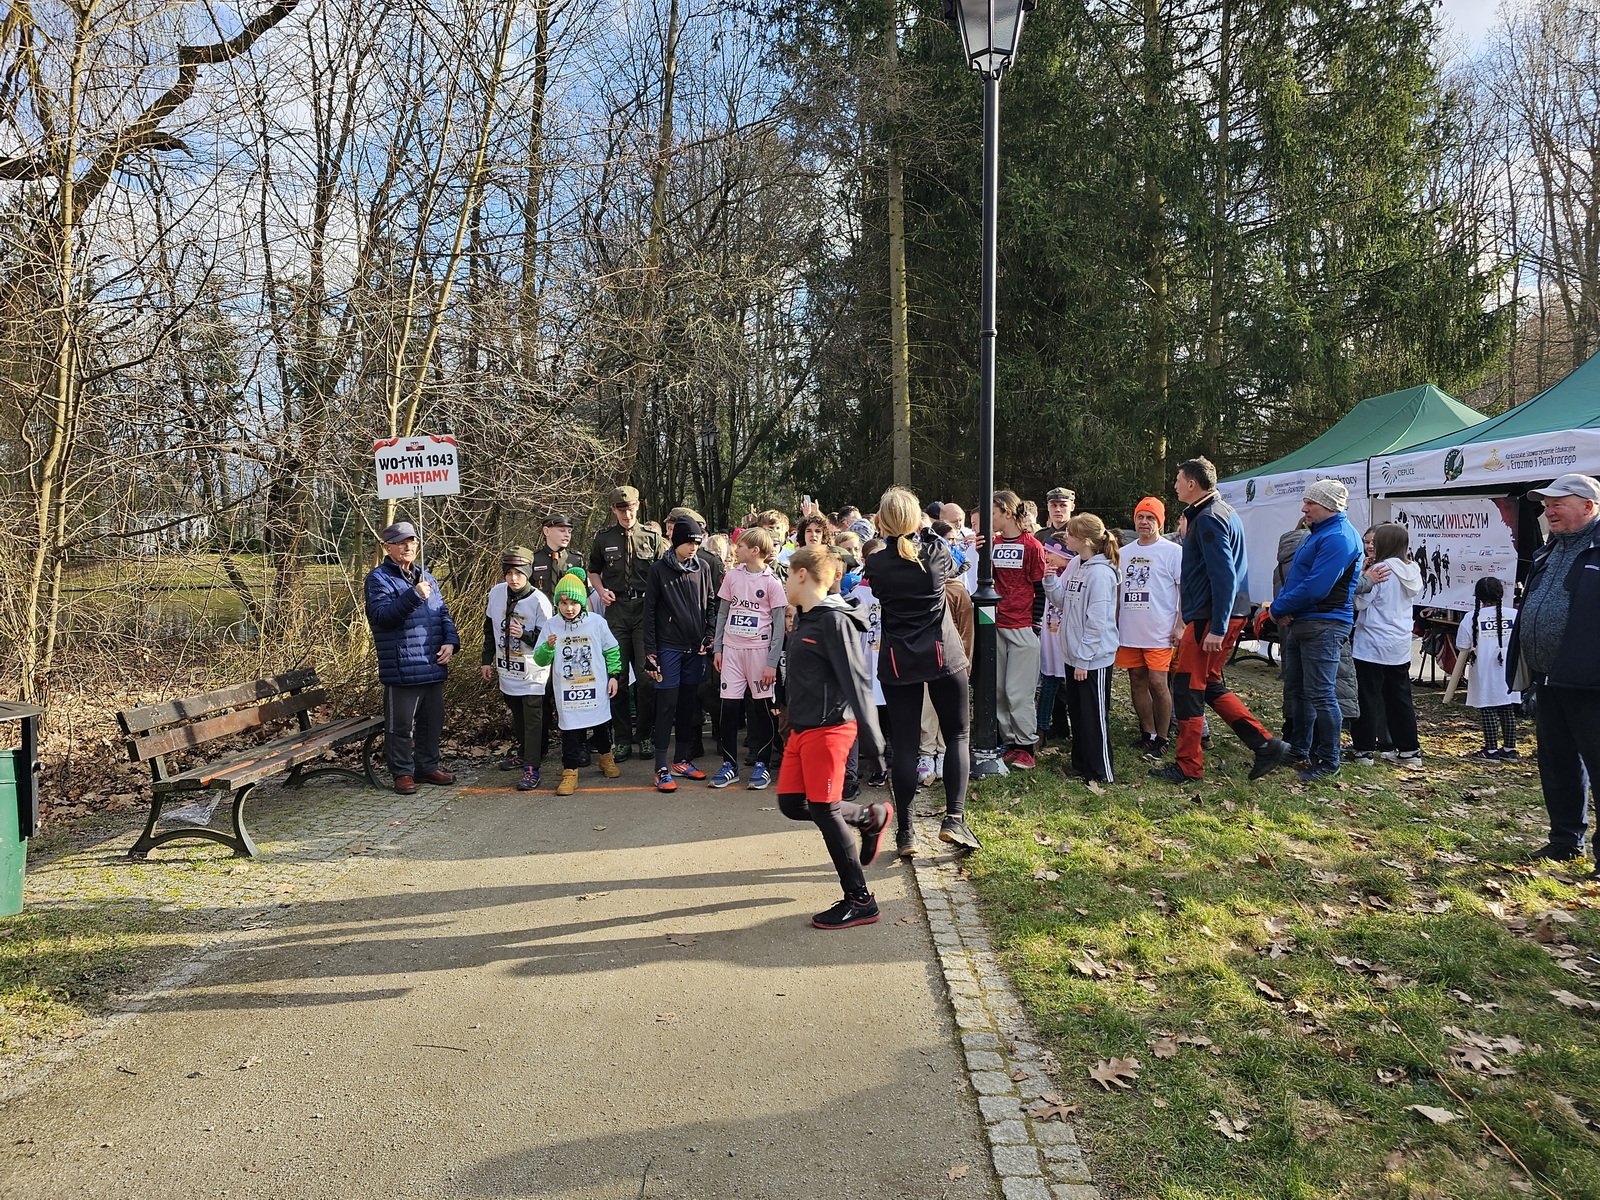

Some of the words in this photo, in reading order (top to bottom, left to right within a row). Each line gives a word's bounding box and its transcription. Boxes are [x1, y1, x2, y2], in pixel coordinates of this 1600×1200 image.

[426, 454, 454, 467] 1943
[385, 470, 449, 486] PAMIĘTAMY
[997, 550, 1018, 558] 060
[1128, 593, 1142, 602] 181
[740, 600, 760, 609] XBTO
[734, 616, 752, 626] 154
[568, 690, 592, 700] 092
